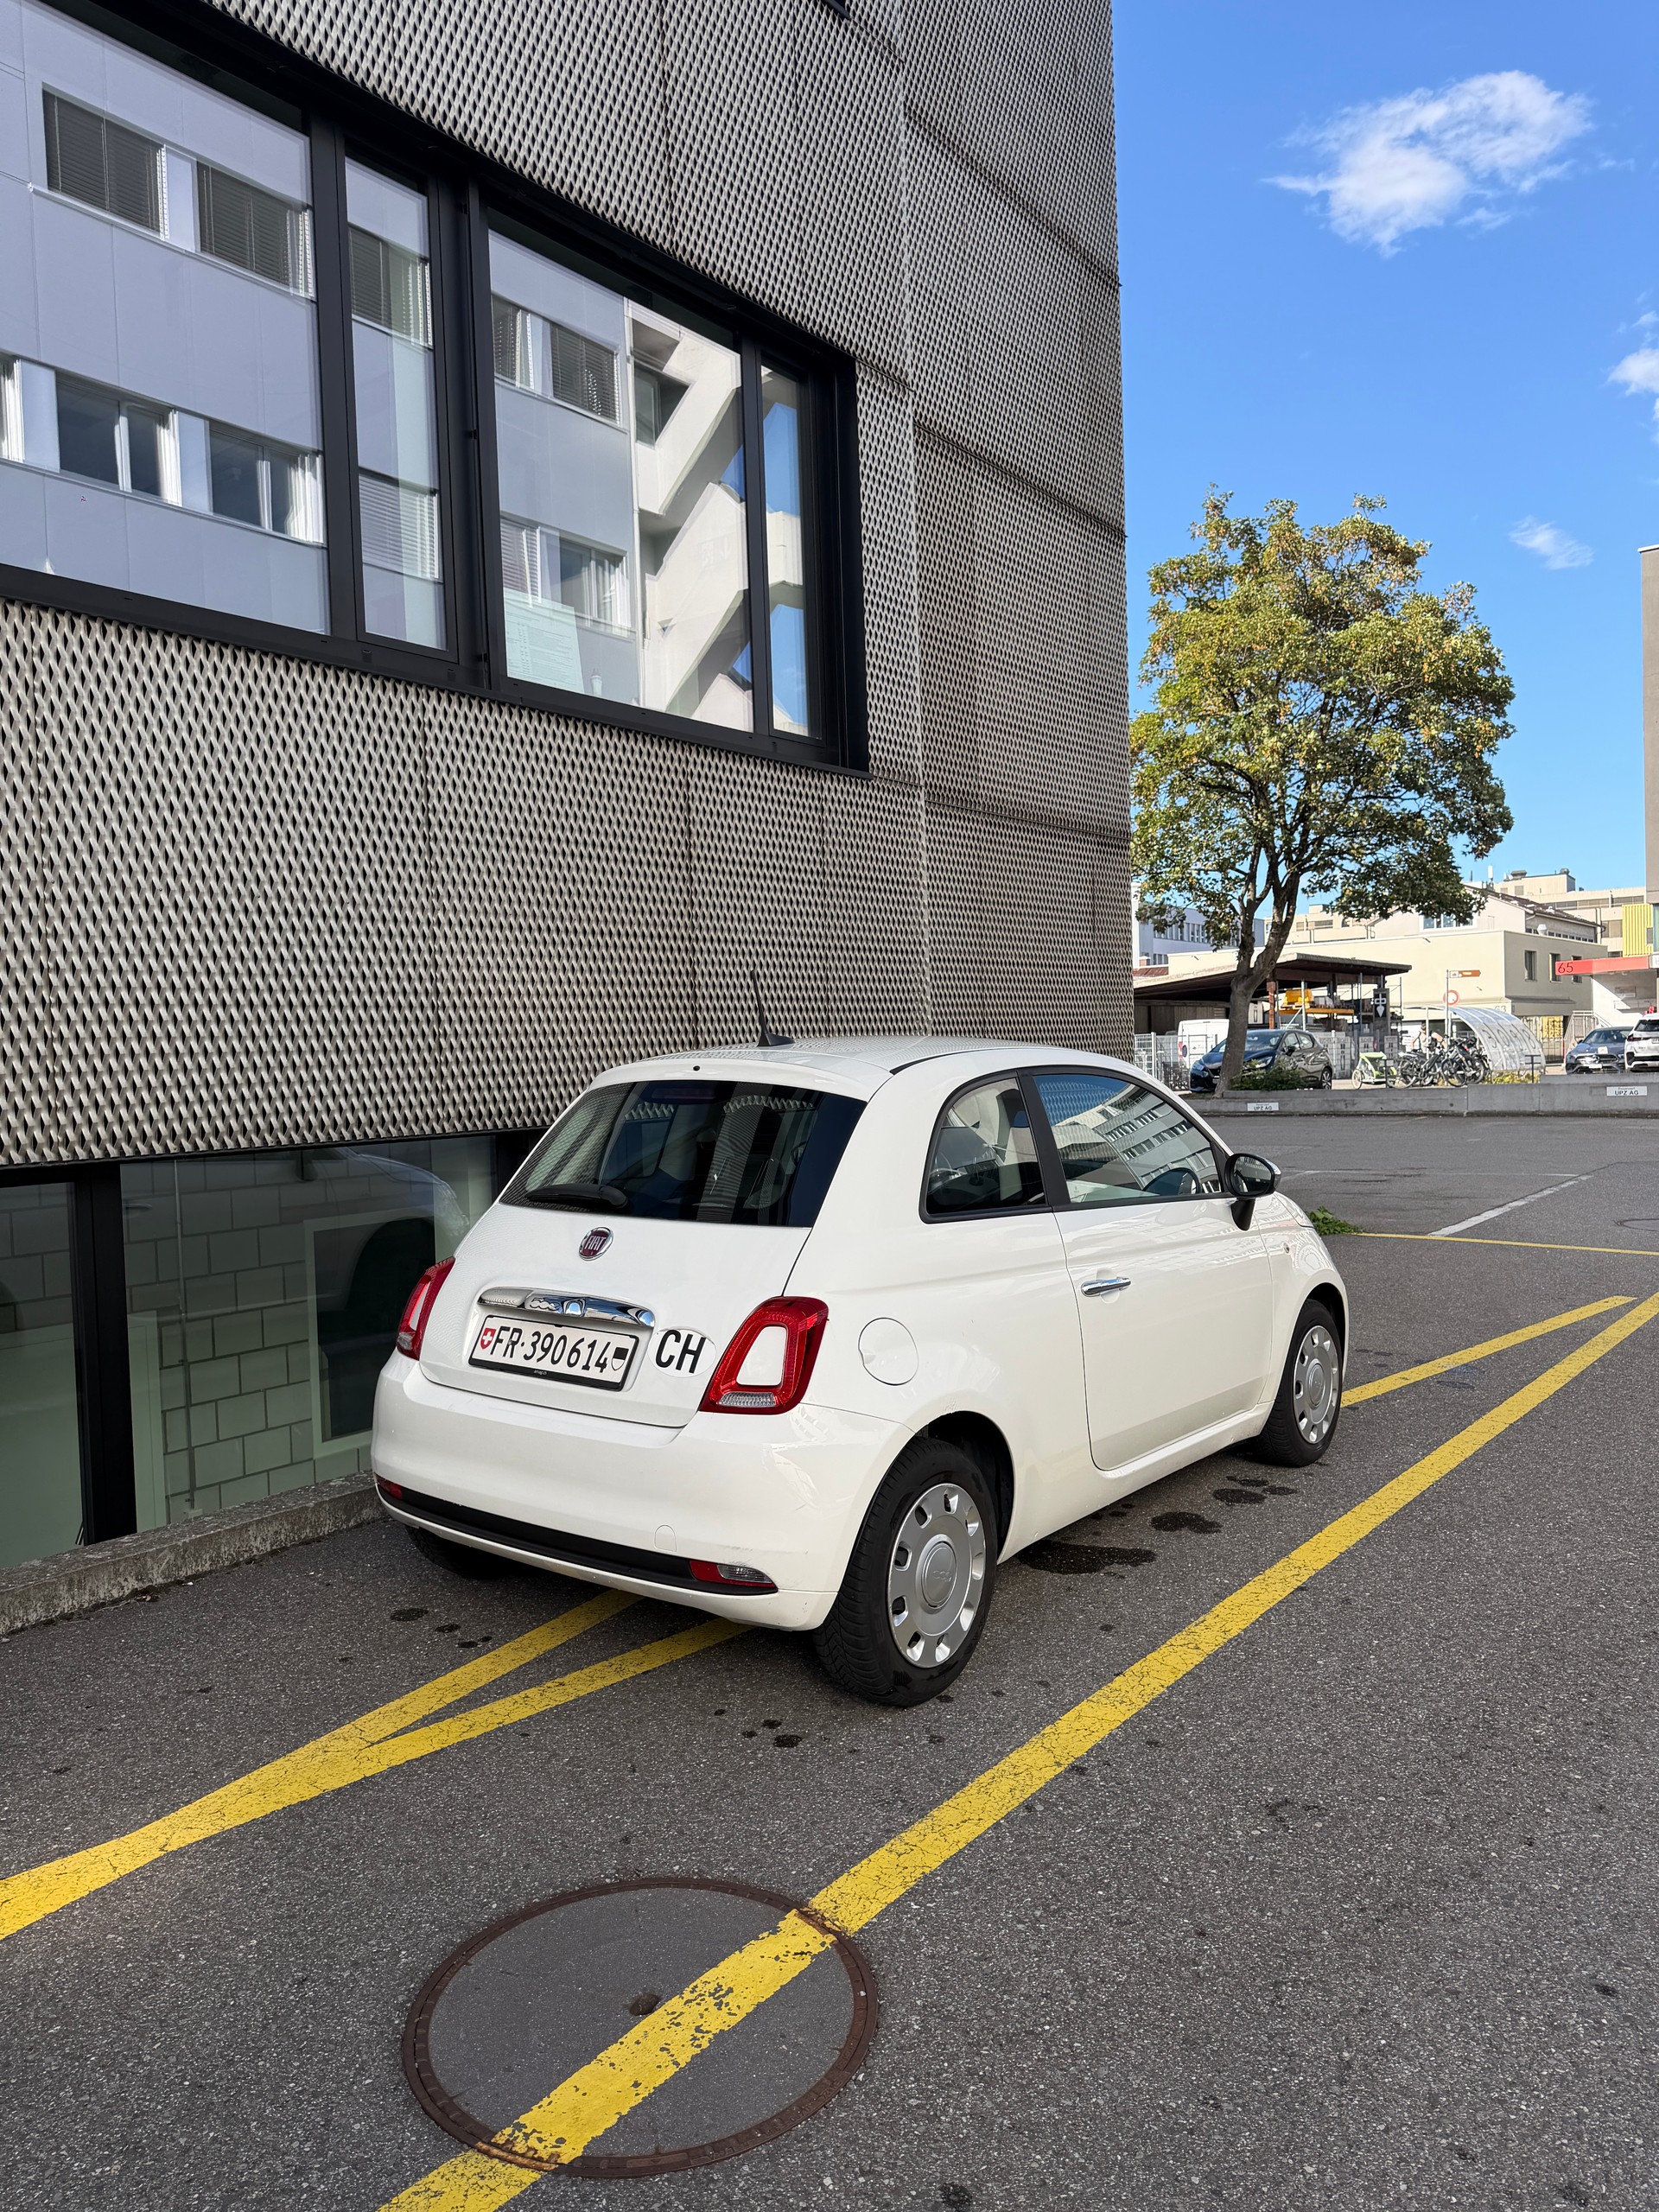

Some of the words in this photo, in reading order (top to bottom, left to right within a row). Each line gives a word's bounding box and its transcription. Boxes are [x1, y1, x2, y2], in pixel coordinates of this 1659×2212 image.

[1557, 962, 1573, 974] 65
[584, 1235, 607, 1251] FIAT
[655, 1329, 707, 1374] CH
